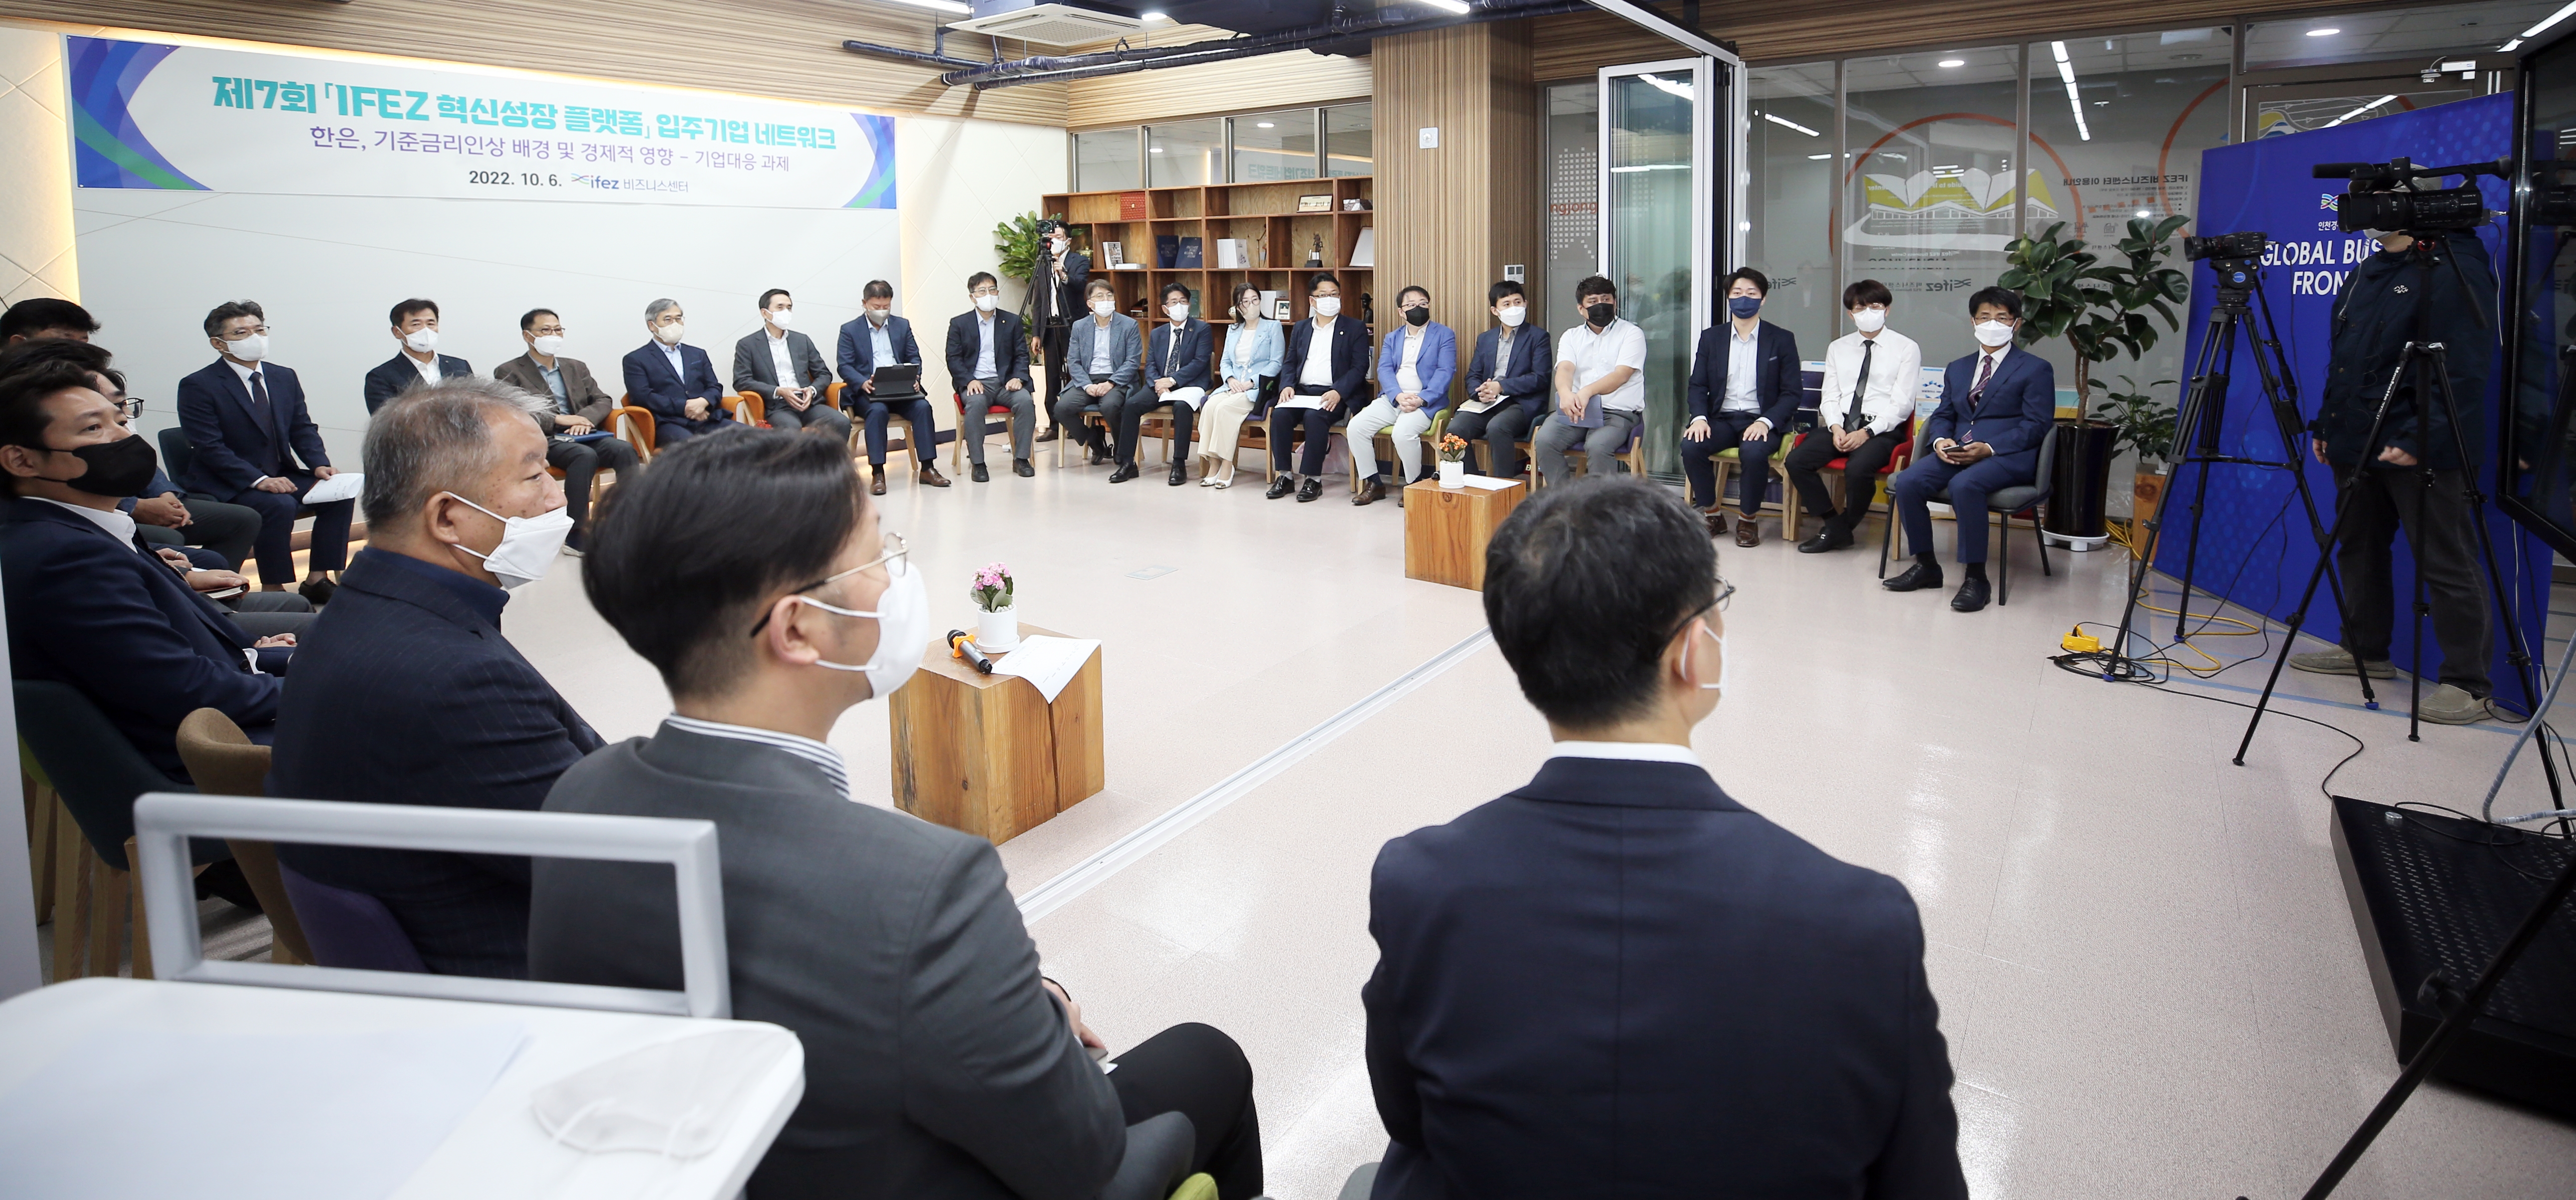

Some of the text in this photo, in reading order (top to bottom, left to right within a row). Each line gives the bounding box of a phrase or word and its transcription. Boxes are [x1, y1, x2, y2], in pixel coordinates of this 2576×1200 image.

[212, 77, 316, 113] 제7회
[436, 94, 558, 129] 혁신성장
[657, 114, 748, 143] 입주기업
[755, 123, 836, 149] 네트워크
[310, 126, 366, 151] 한은,
[375, 131, 505, 157] 기준금리인상
[513, 140, 549, 159] 배경
[557, 141, 574, 161] 및
[582, 144, 632, 163] 경제적
[639, 146, 673, 166] 영향
[695, 151, 757, 171] 기업대응
[761, 155, 790, 172] 과제
[469, 171, 561, 186] 2022. 10. 6.
[590, 175, 689, 193] ifez 비즈니스센터
[2318, 221, 2338, 231] 인천경
[2260, 240, 2335, 266] GLOBAL
